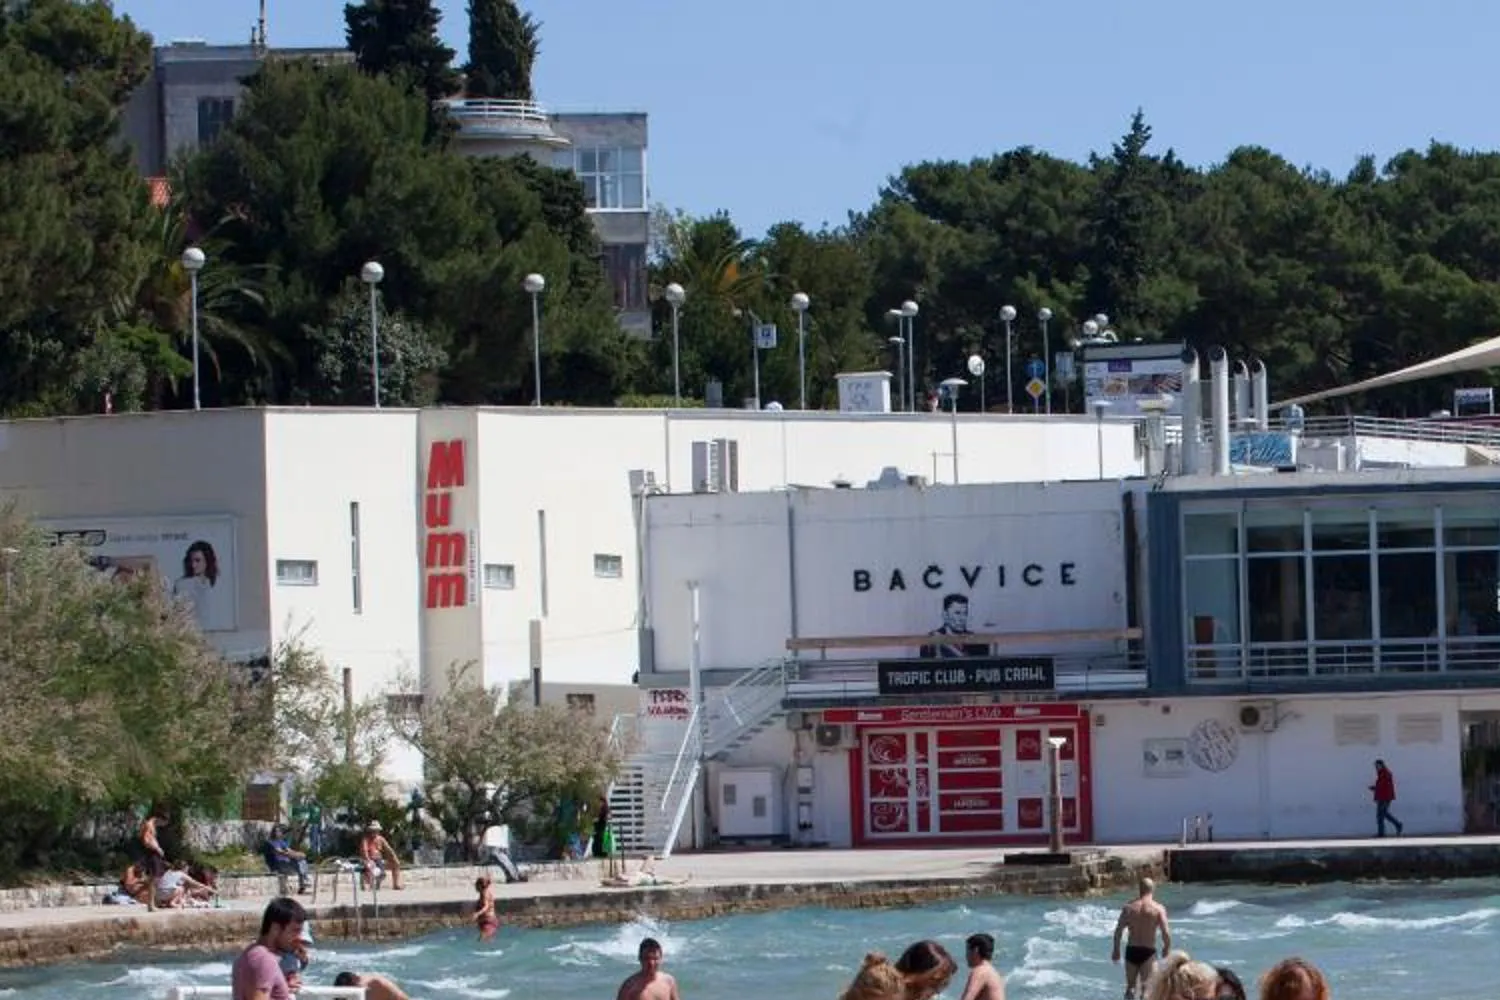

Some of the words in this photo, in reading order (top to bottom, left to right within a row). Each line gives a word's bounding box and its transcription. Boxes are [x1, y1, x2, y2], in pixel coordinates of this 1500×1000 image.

[426, 439, 466, 608] Mumm
[853, 562, 1076, 592] BAČVICE
[886, 671, 931, 686] TROPIC
[934, 668, 966, 684] CLUB
[975, 668, 1001, 683] PUB
[1003, 665, 1046, 682] CRAWL
